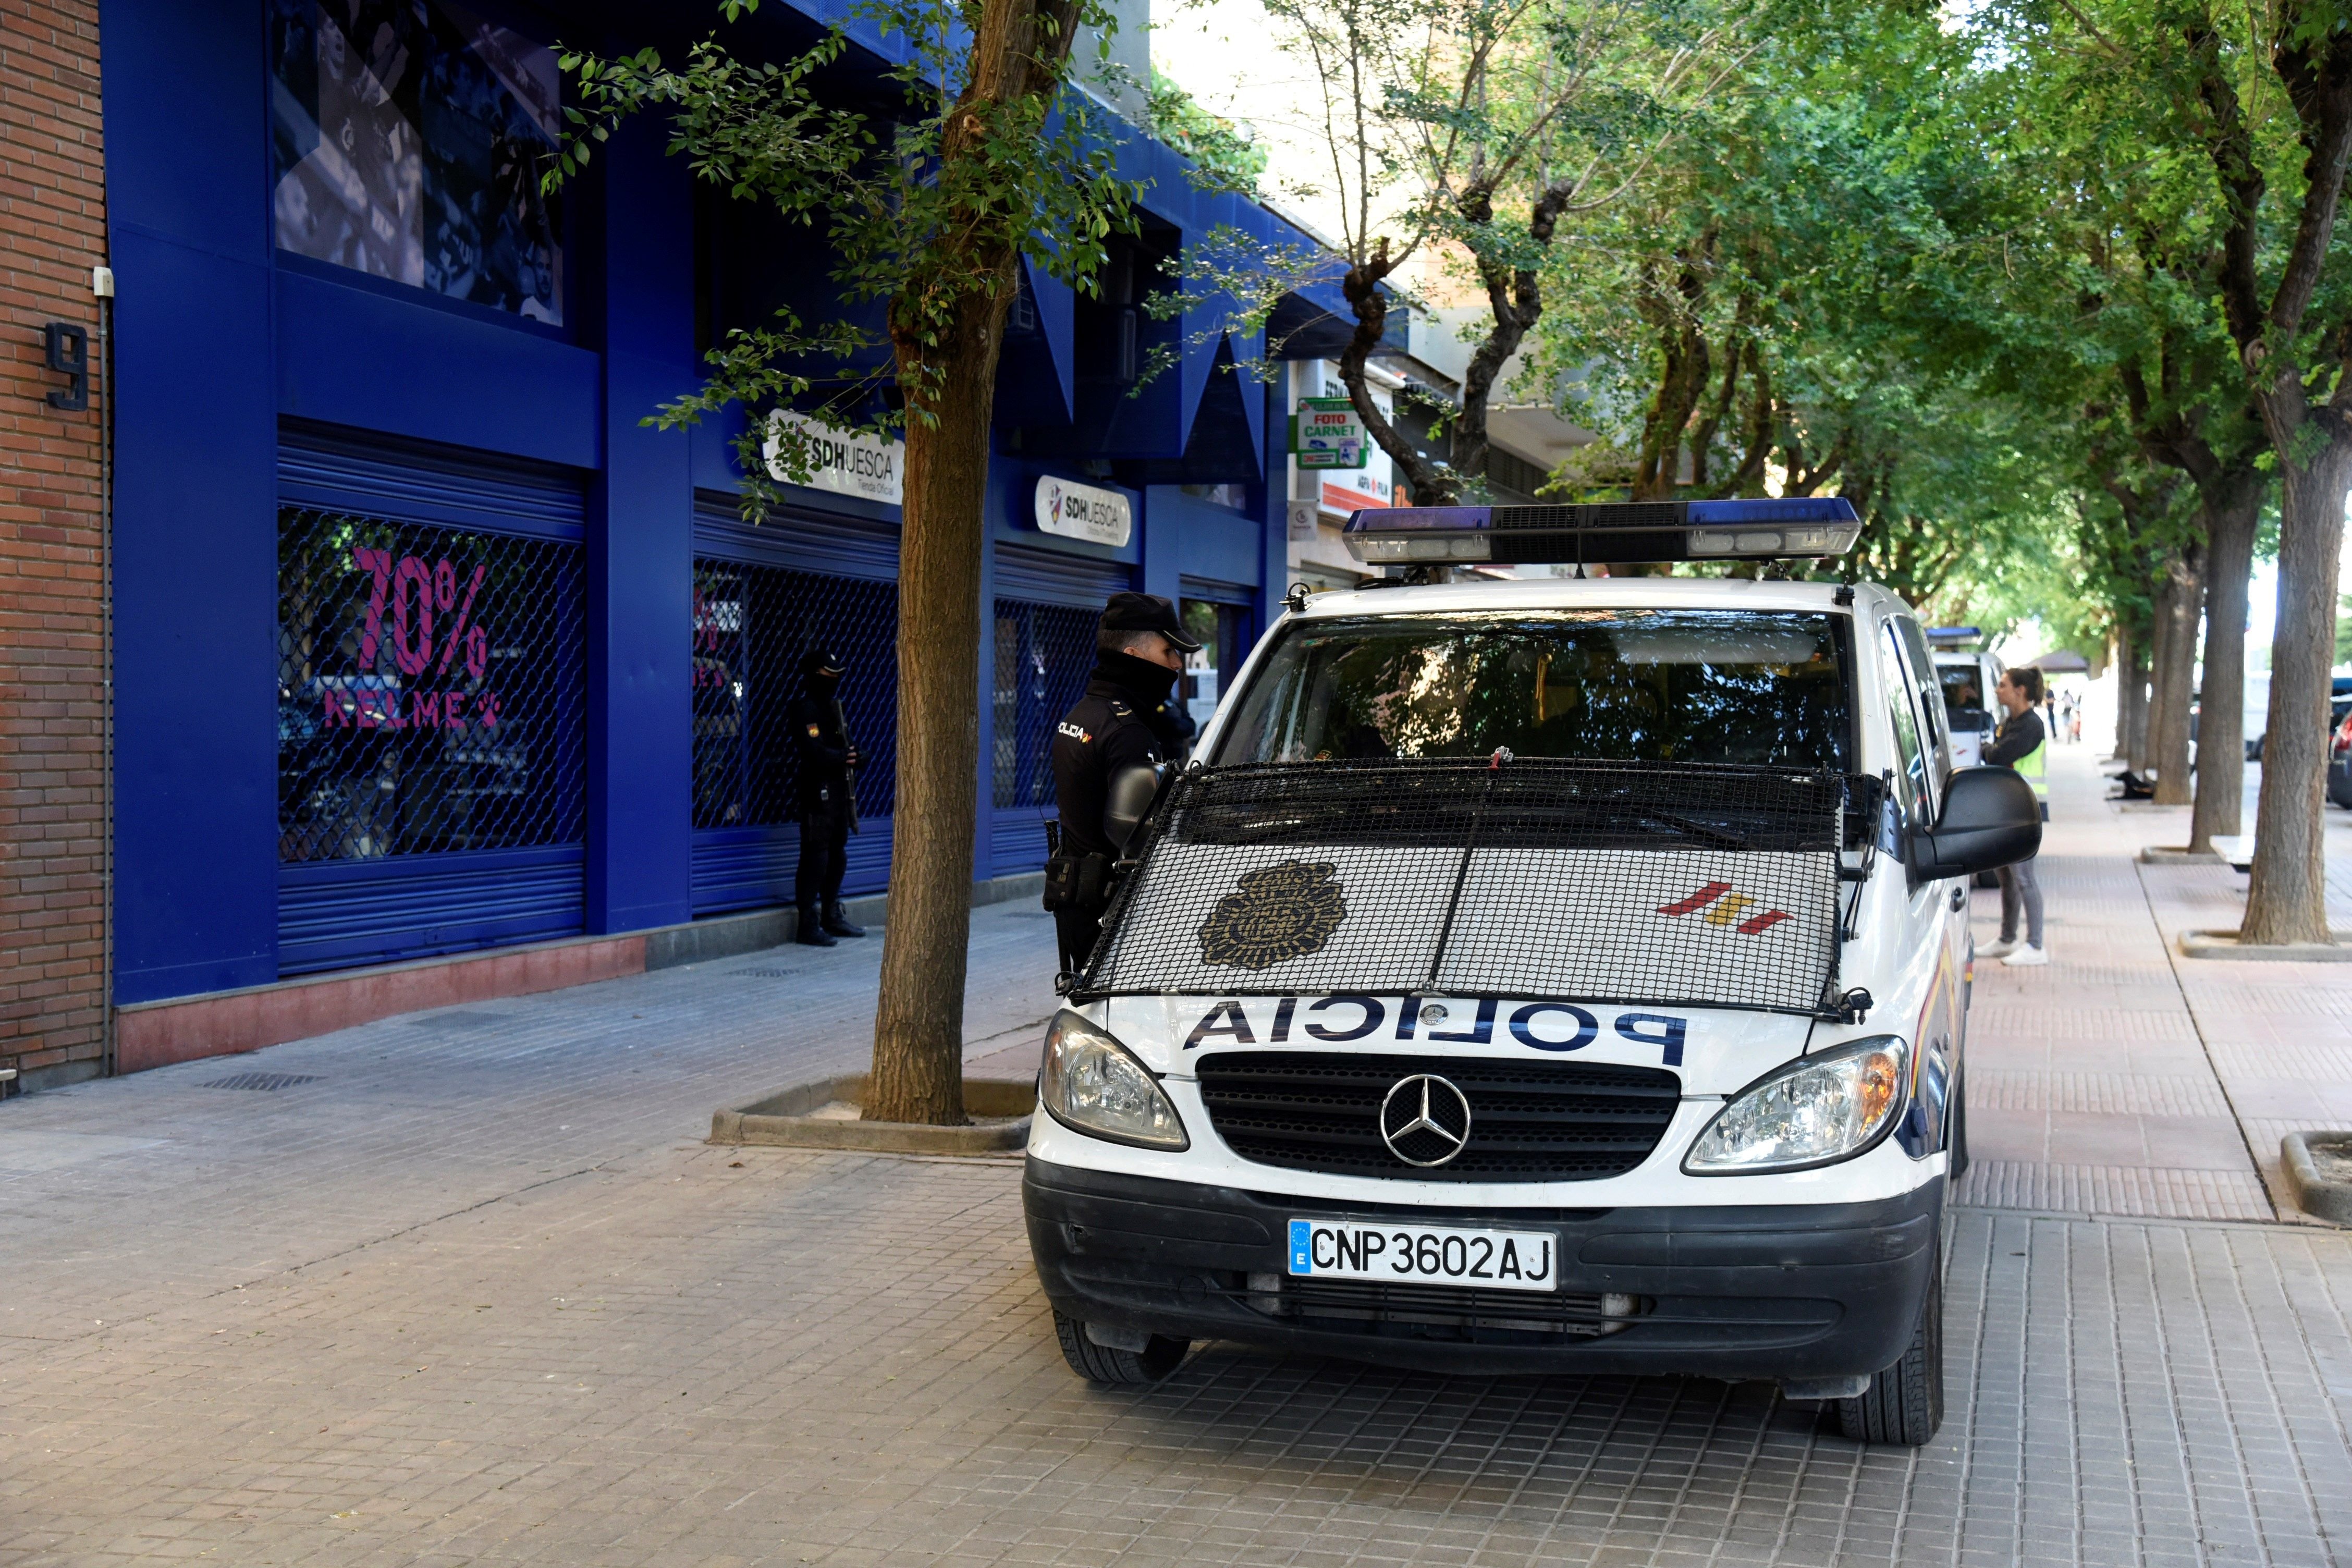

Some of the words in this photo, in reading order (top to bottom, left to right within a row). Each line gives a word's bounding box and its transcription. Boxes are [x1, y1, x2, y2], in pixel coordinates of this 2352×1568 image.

[45, 322, 88, 411] 9
[1305, 425, 1356, 437] CARNET
[1314, 414, 1346, 425] FOTO
[812, 437, 893, 481] SDHUESCA
[353, 546, 487, 677] 70%
[323, 689, 467, 728] KELME
[1296, 1253, 1305, 1265] E
[1312, 1228, 1550, 1281] CNP3602AJ
